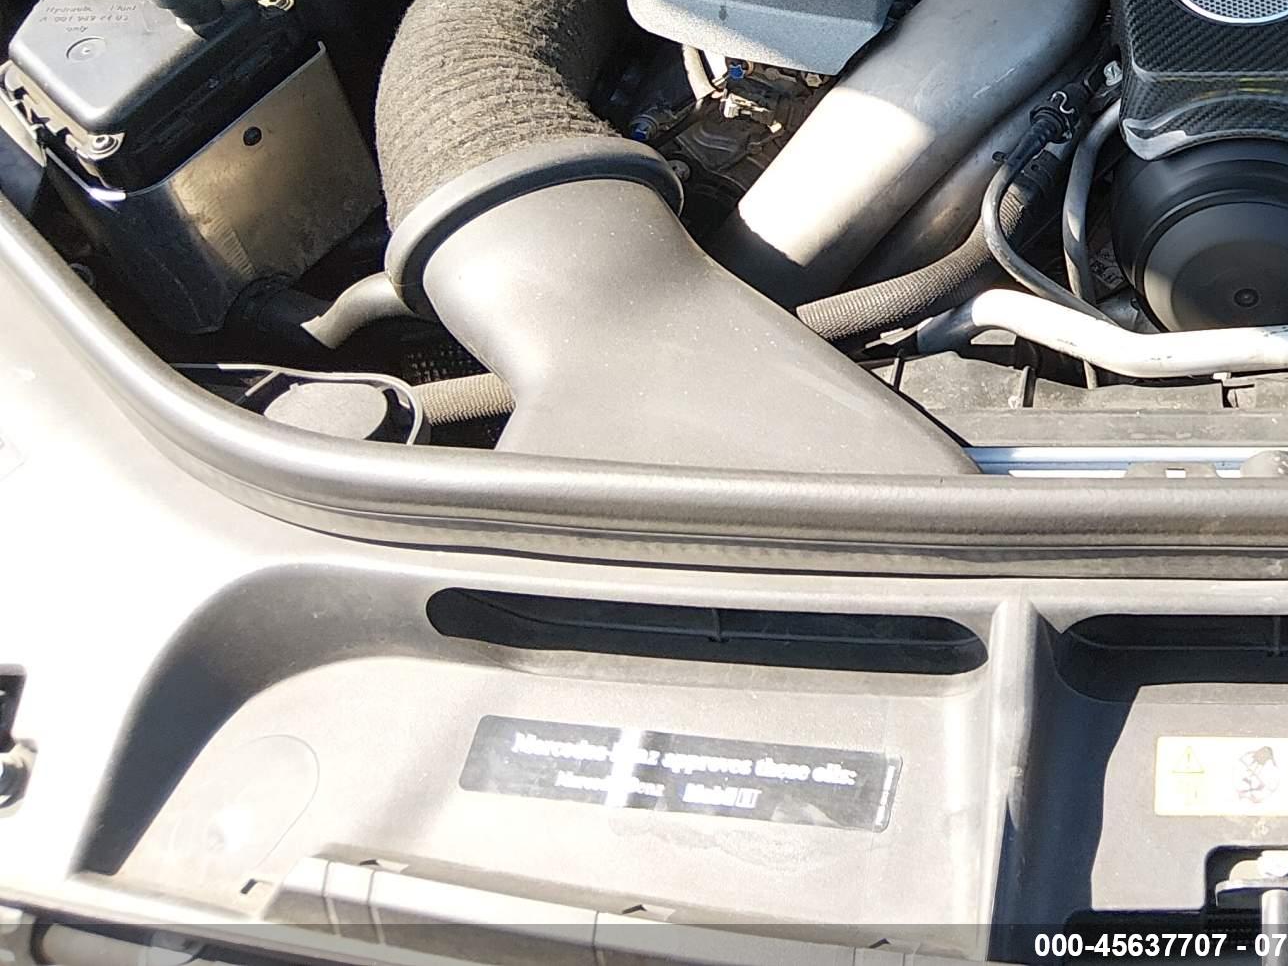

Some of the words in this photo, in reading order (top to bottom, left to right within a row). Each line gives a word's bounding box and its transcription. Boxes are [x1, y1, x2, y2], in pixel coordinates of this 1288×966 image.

[511, 731, 660, 765] Mercedes-nz
[661, 751, 752, 774] approves
[755, 756, 811, 781] these
